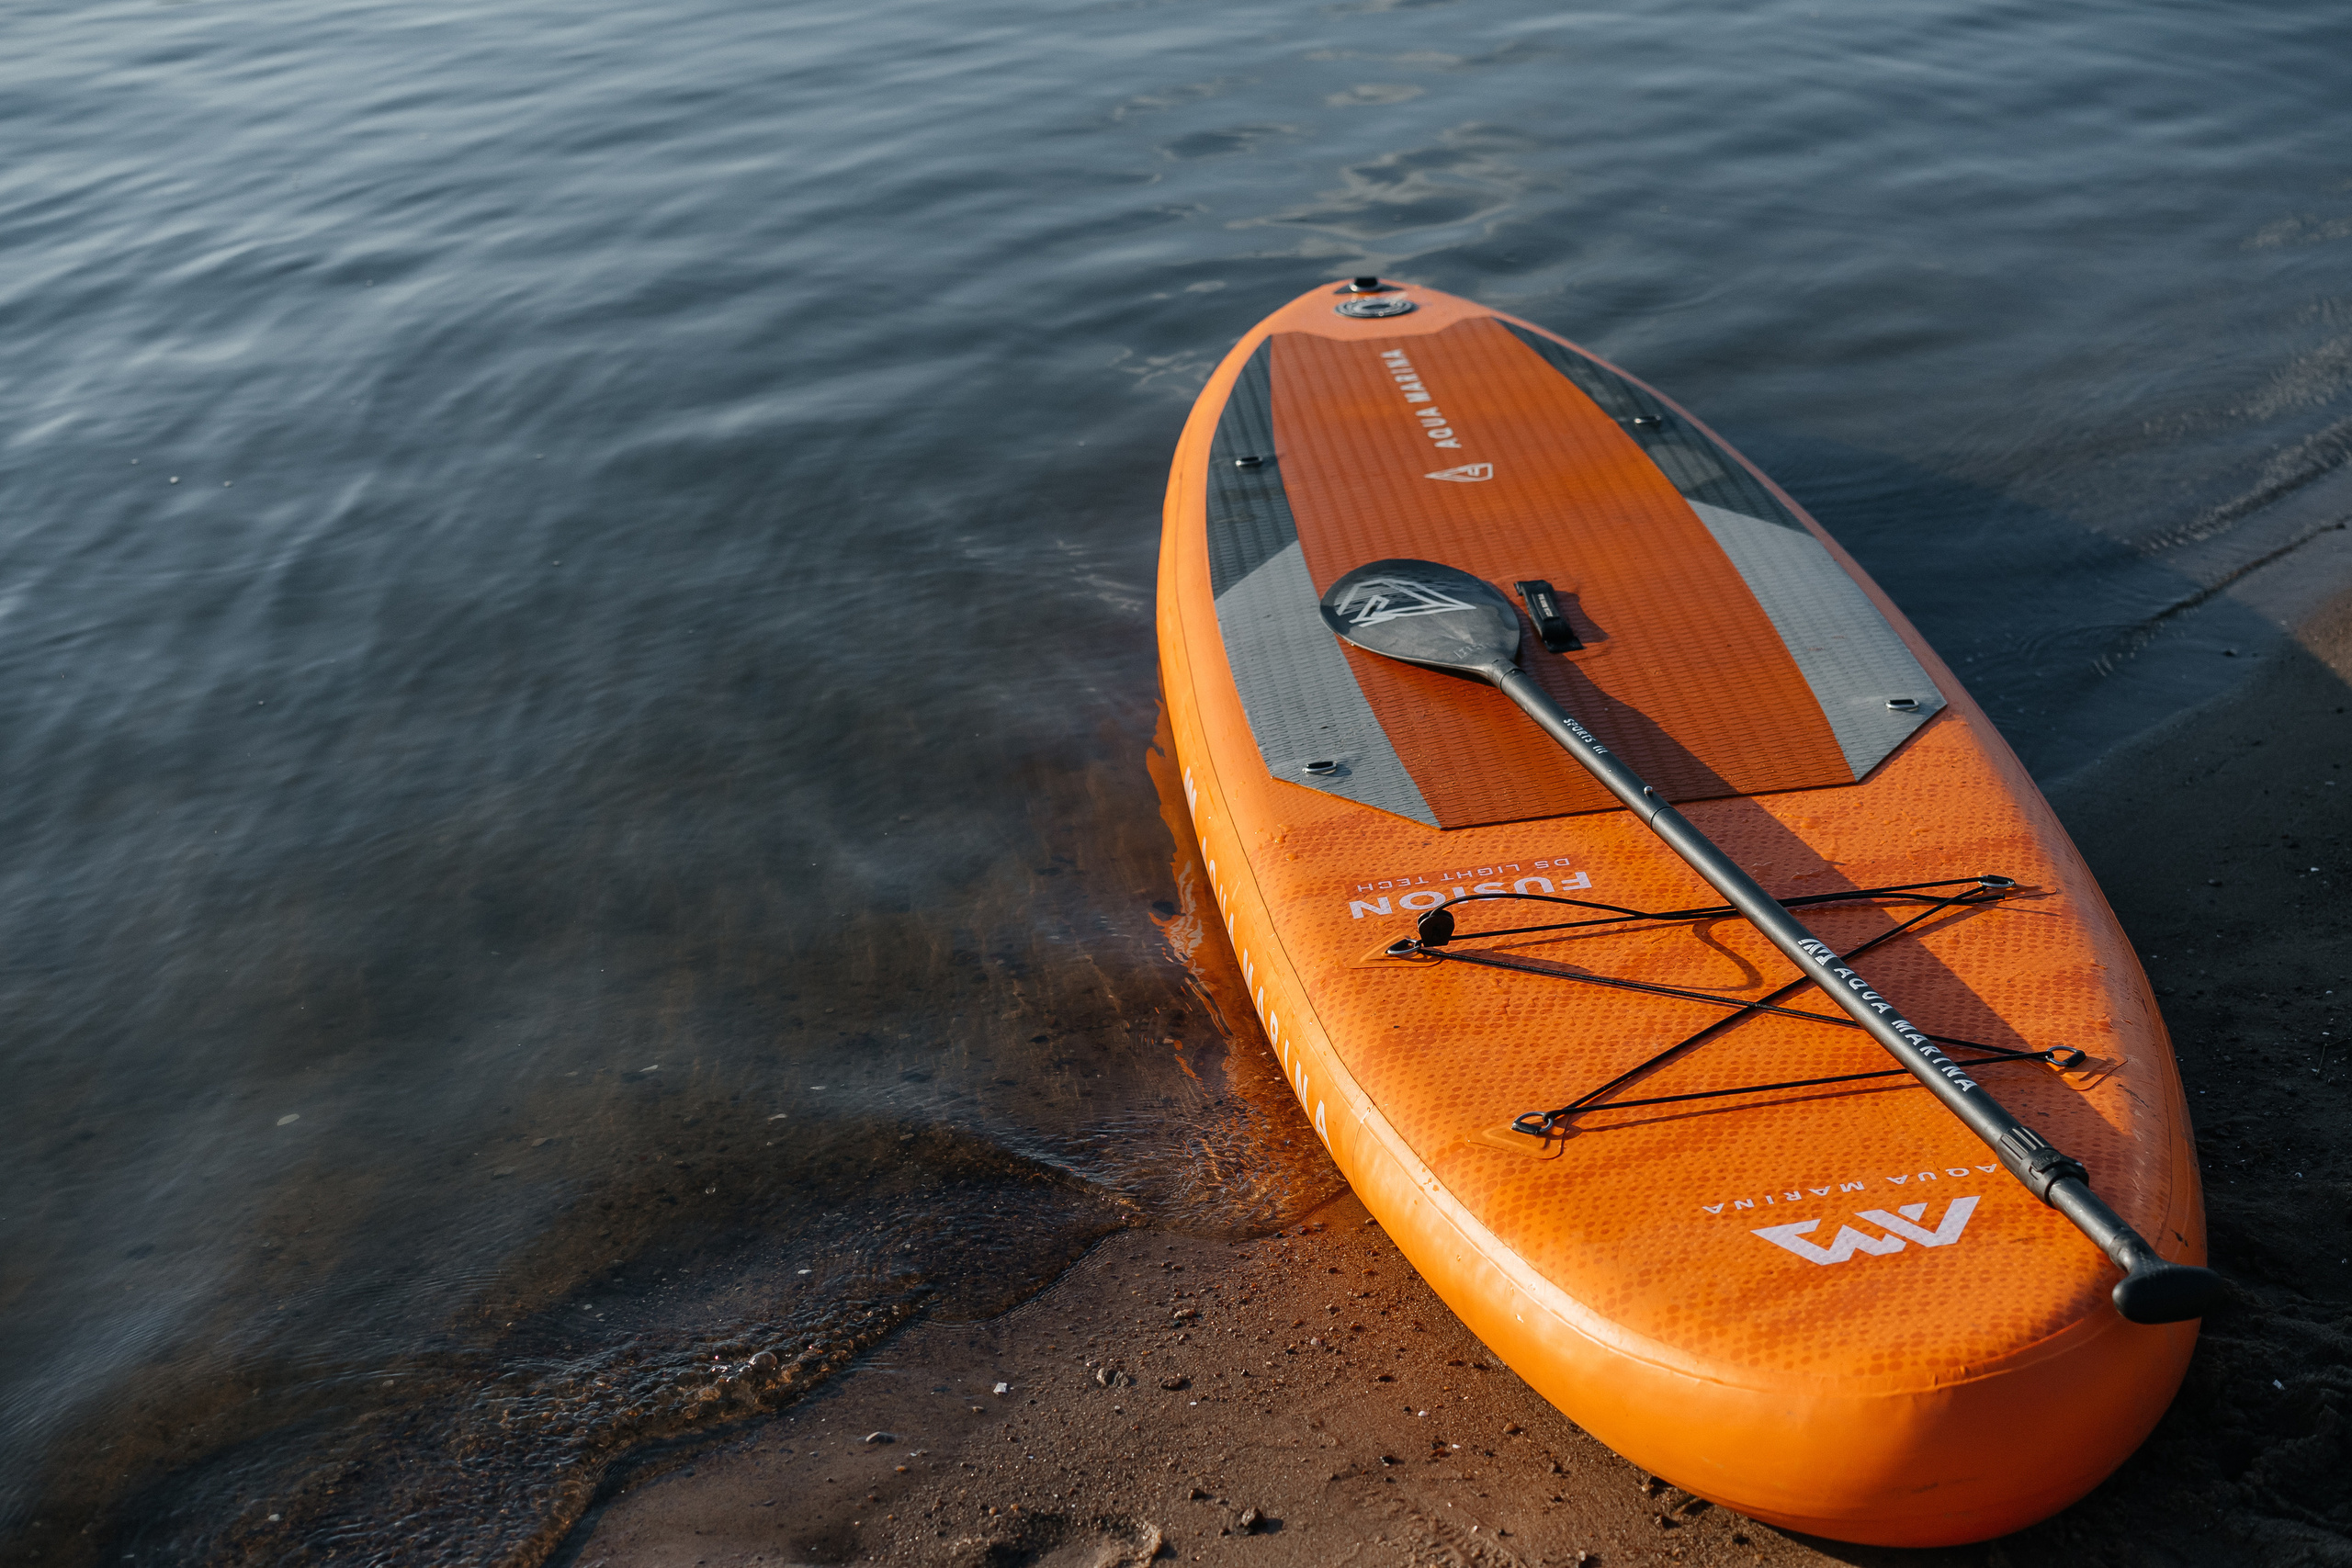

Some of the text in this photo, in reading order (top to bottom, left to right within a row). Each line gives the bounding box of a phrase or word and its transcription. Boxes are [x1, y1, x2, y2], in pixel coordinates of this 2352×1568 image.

[1380, 348, 1463, 449] AQUA MARINA
[1563, 718, 1597, 743] SPORTS
[1349, 871, 1593, 919] FUSION
[1357, 858, 1570, 893] DS LIGHT TECH
[1834, 967, 1894, 1014] AQUA
[1891, 1020, 1978, 1092] MARINA
[1702, 1163, 1998, 1214] AQUA MARINA
